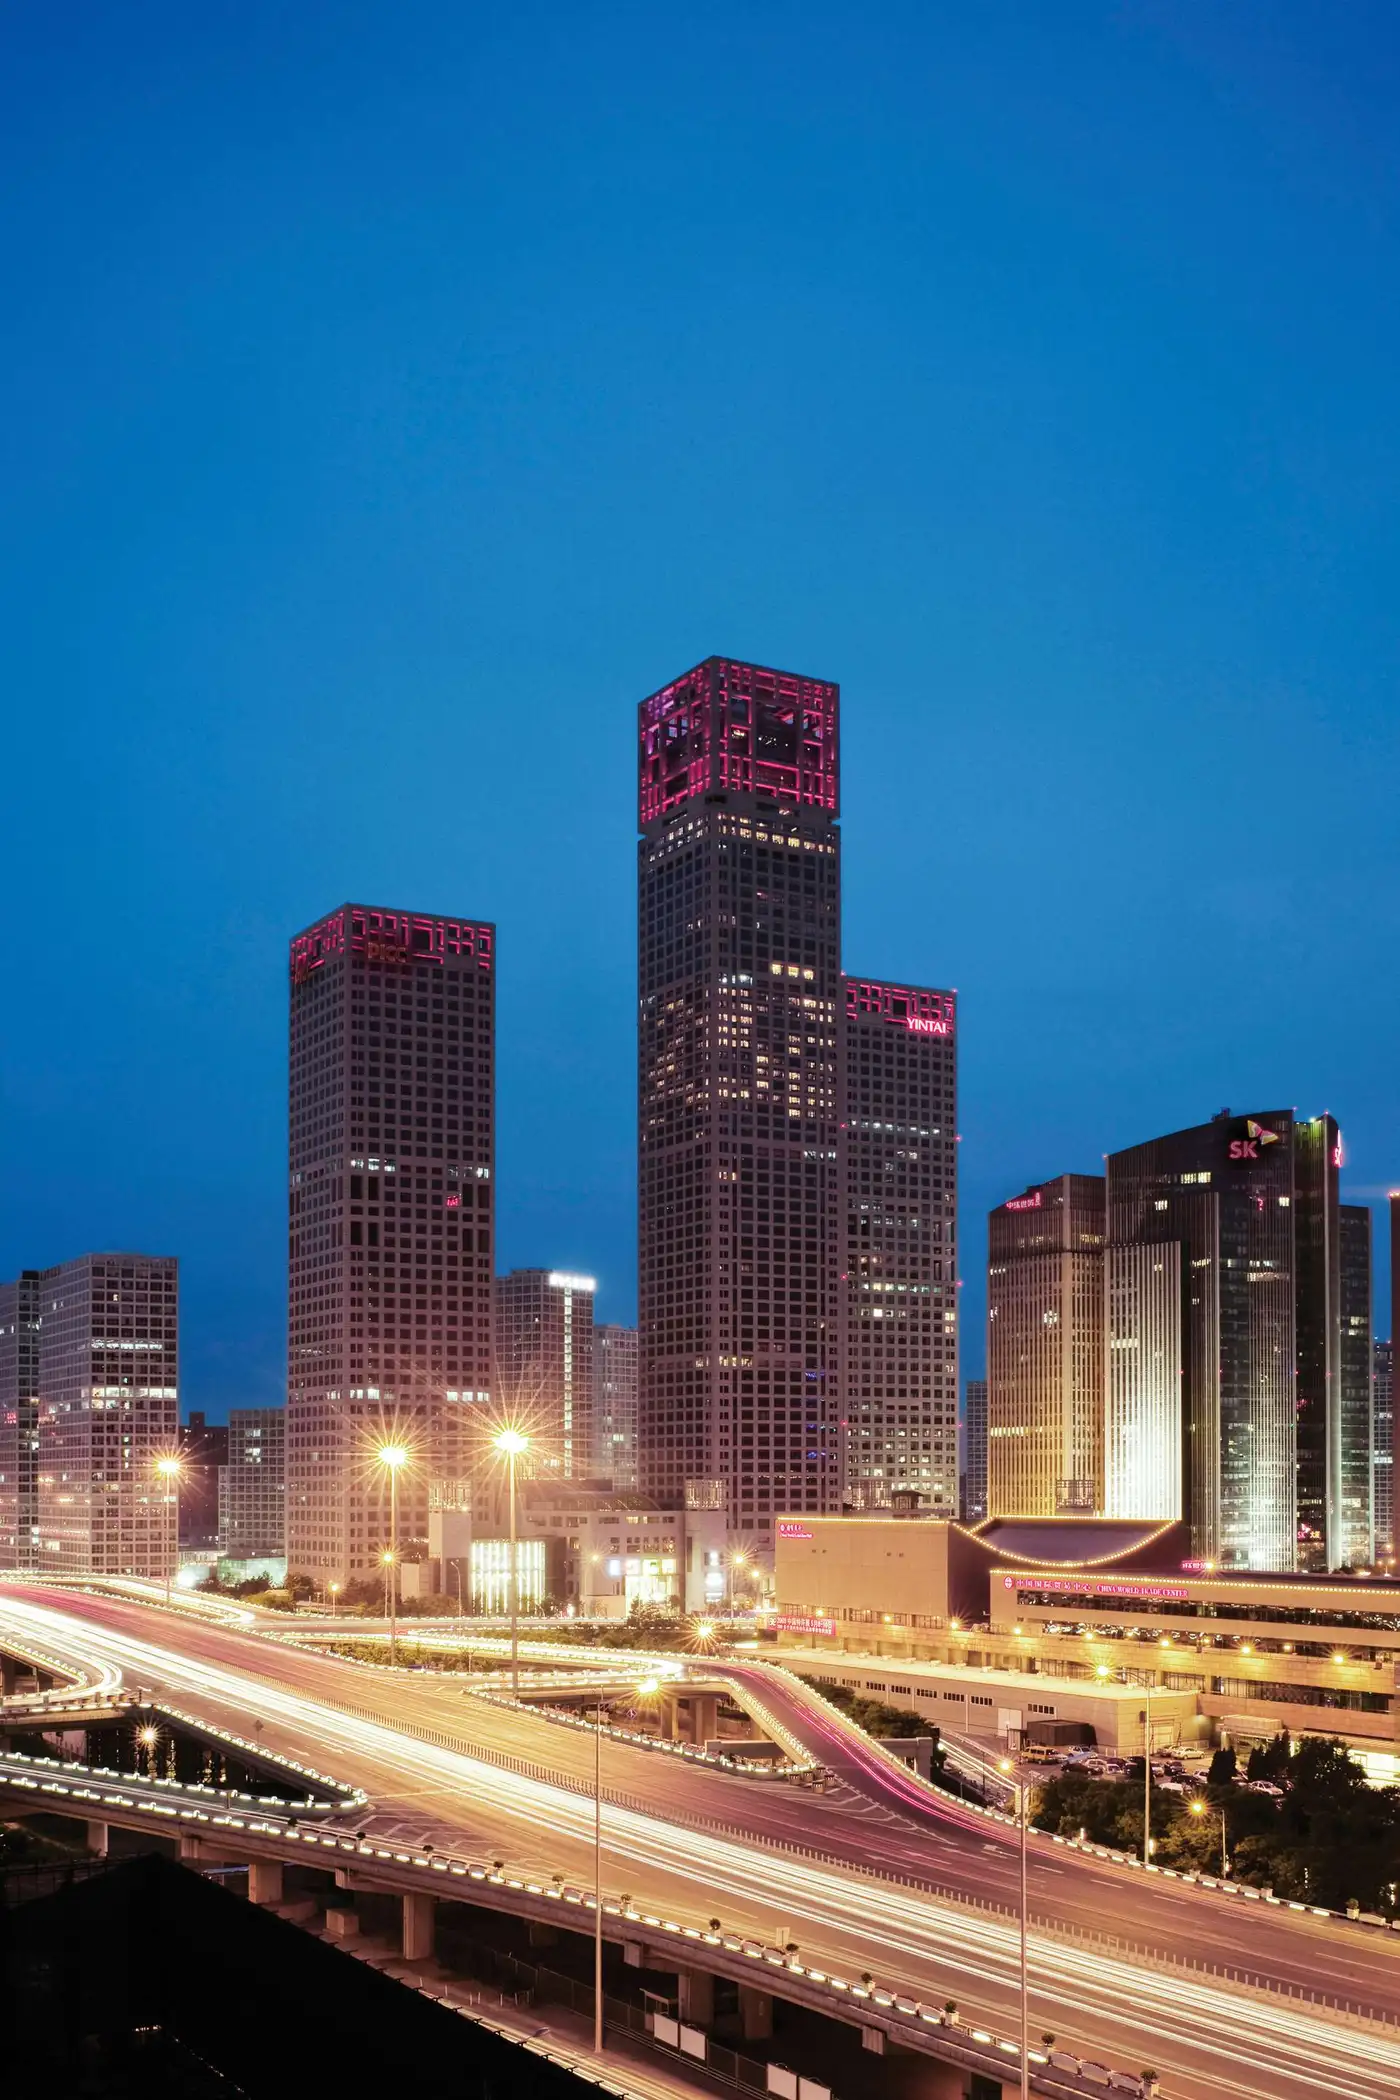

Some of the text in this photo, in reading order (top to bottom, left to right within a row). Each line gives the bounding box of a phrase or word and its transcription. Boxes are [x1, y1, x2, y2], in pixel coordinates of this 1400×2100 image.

[368, 942, 406, 963] PICC
[907, 1017, 947, 1033] YINTAI
[1229, 1140, 1258, 1159] SK
[1016, 1580, 1092, 1592] 中国国际贸易中心
[1096, 1585, 1188, 1597] CHINA WORLD TRADE CENTER
